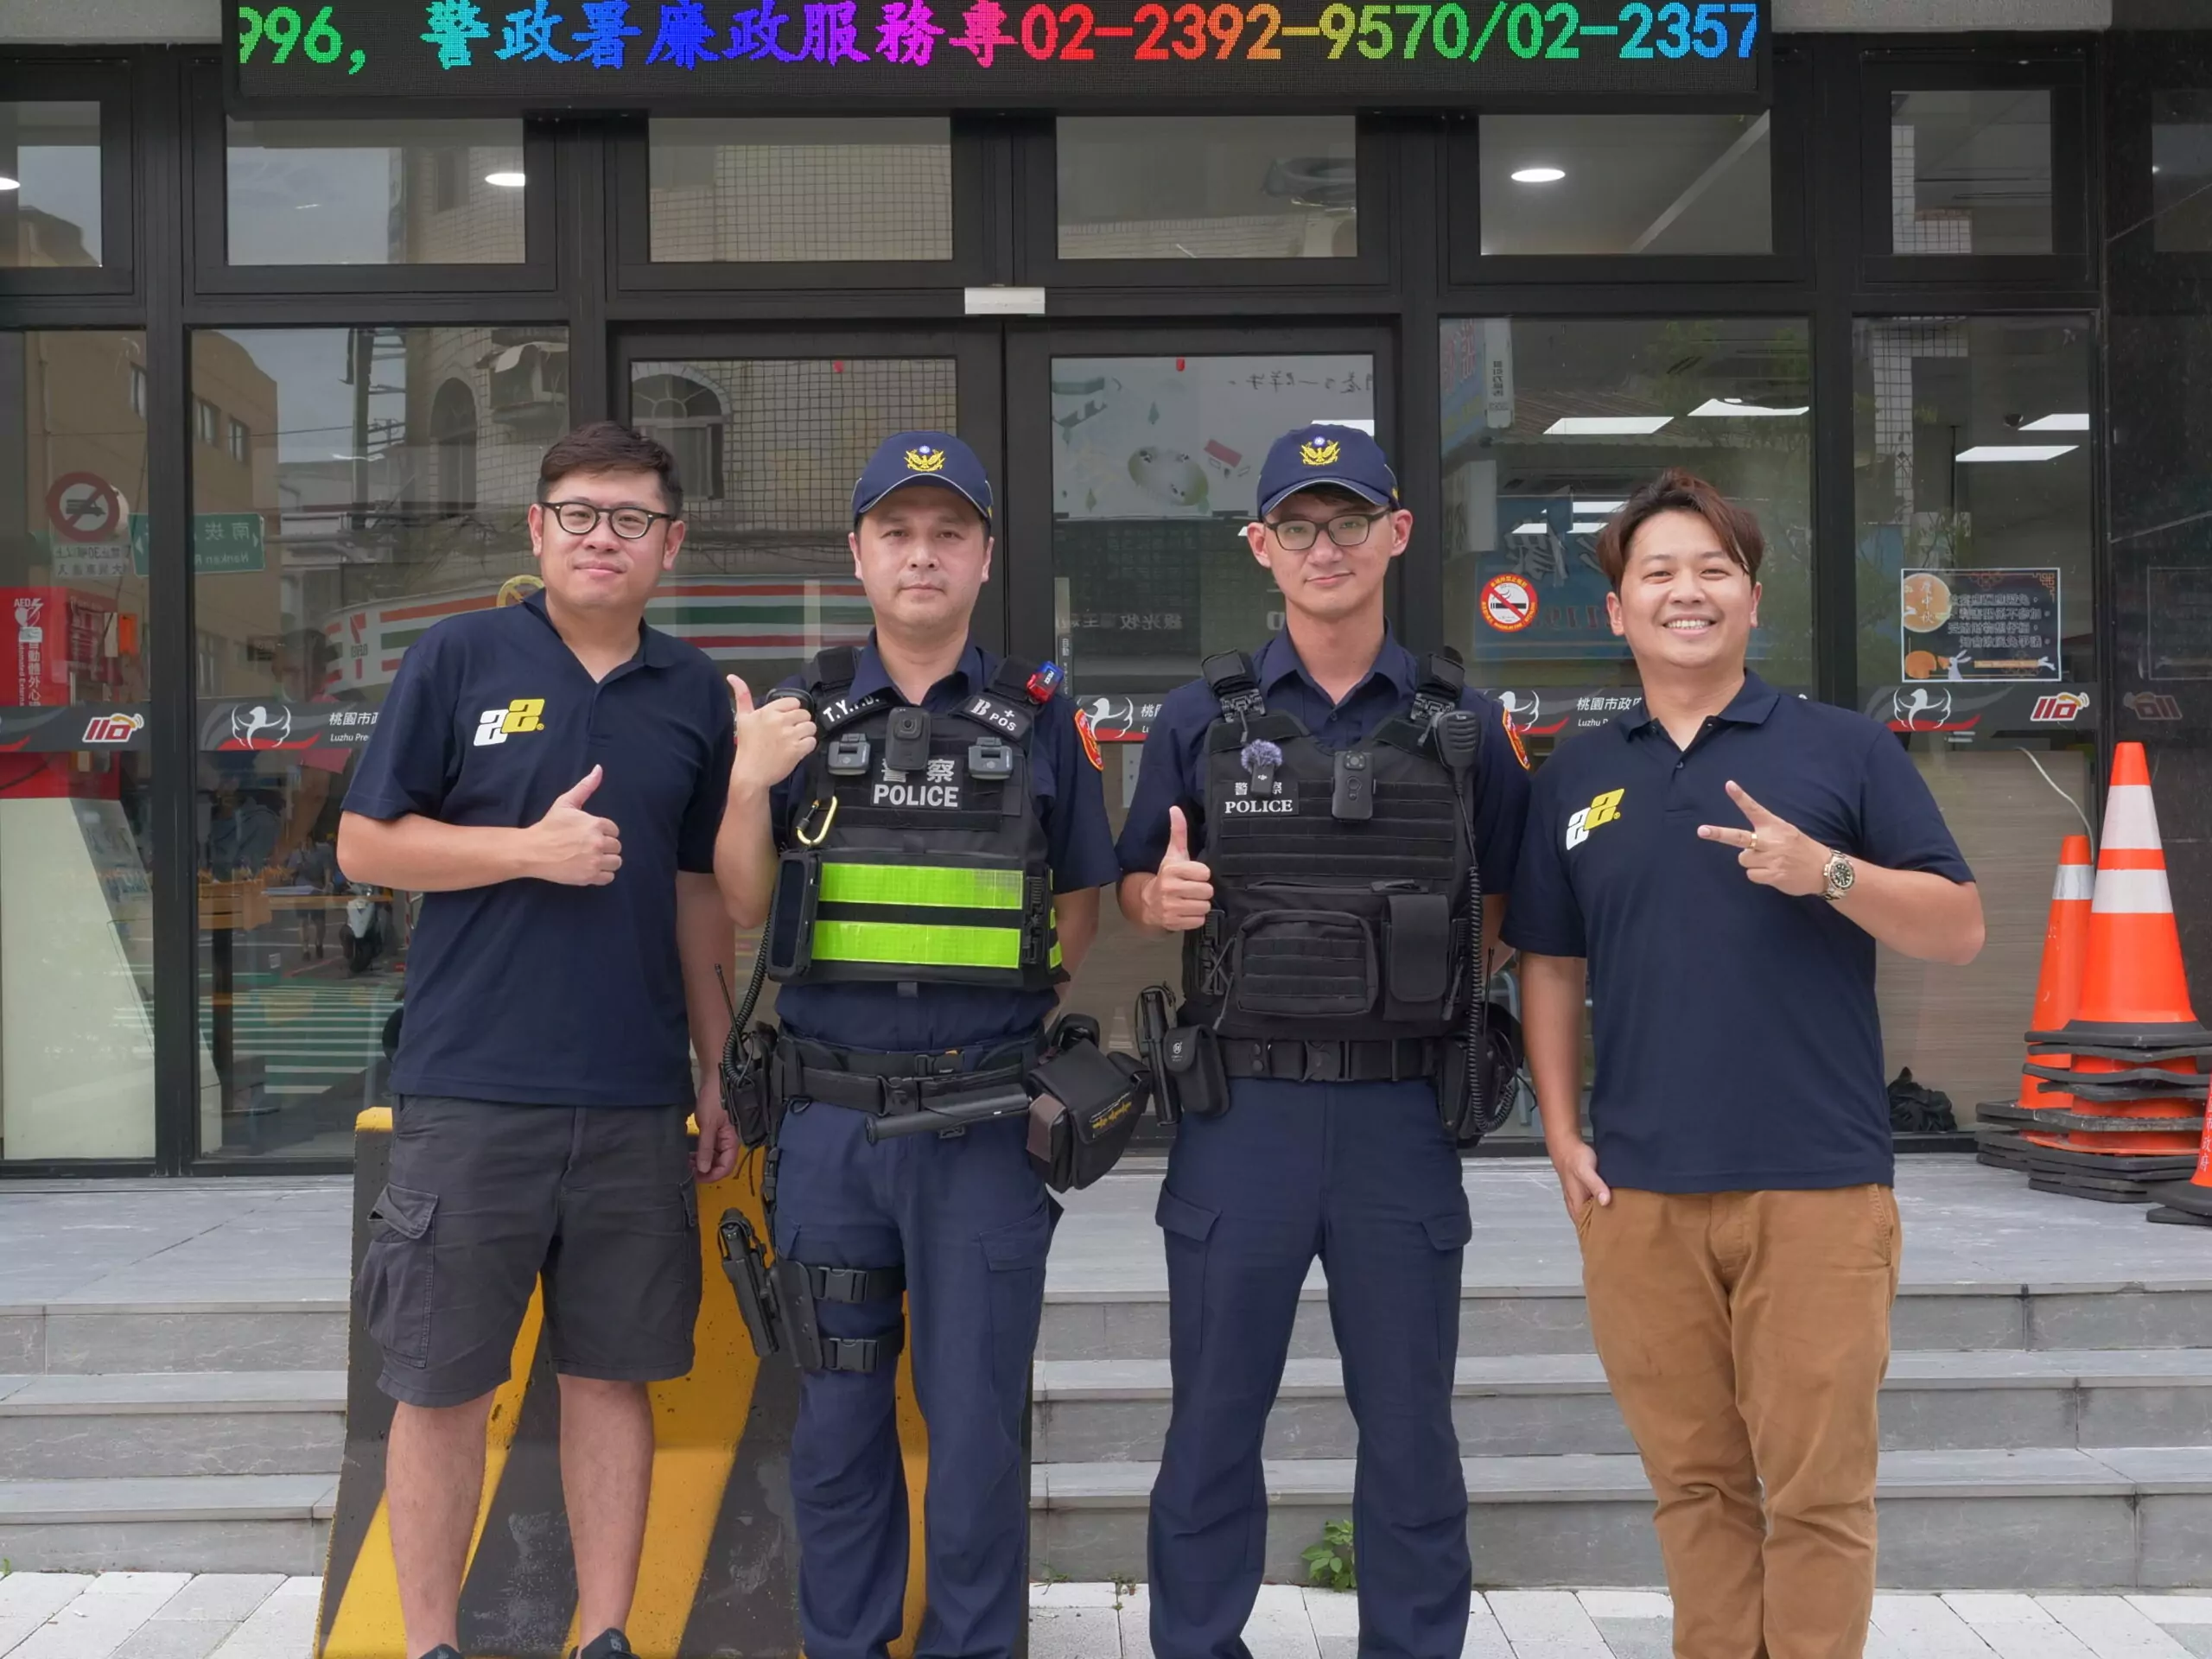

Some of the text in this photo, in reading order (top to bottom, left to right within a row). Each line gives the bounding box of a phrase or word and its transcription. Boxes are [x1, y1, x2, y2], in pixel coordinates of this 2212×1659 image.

[14, 598, 31, 607] AED
[989, 712, 1018, 732] POS
[1577, 718, 1601, 727] Luzhu
[330, 733, 354, 742] Luzhu
[873, 783, 959, 808] POLICE
[1224, 798, 1294, 814] POLICE
